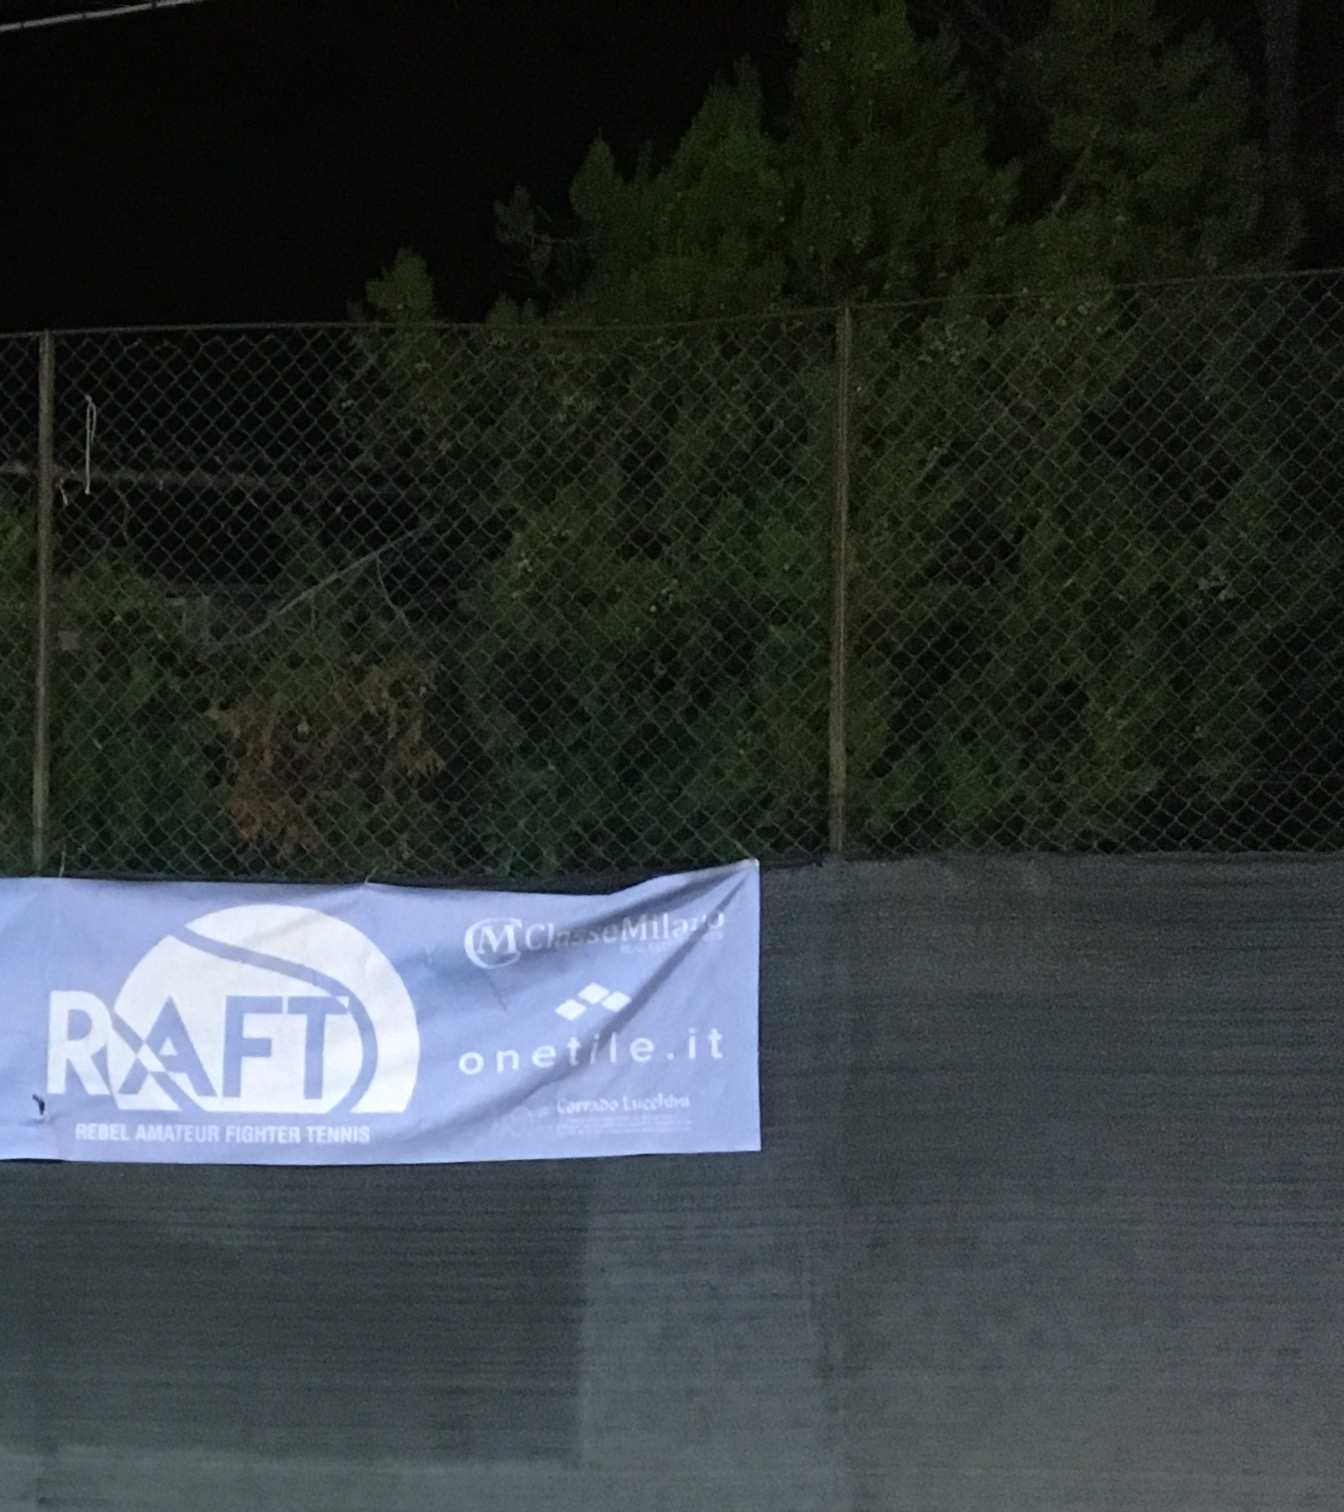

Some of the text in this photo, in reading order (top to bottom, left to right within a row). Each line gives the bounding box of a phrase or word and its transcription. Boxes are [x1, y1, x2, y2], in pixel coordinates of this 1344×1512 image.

[47, 990, 349, 1099] RAFT
[459, 1027, 725, 1076] onetile.it
[75, 1122, 370, 1144] REBEL AMATEUR FIGHTER TENNIS
